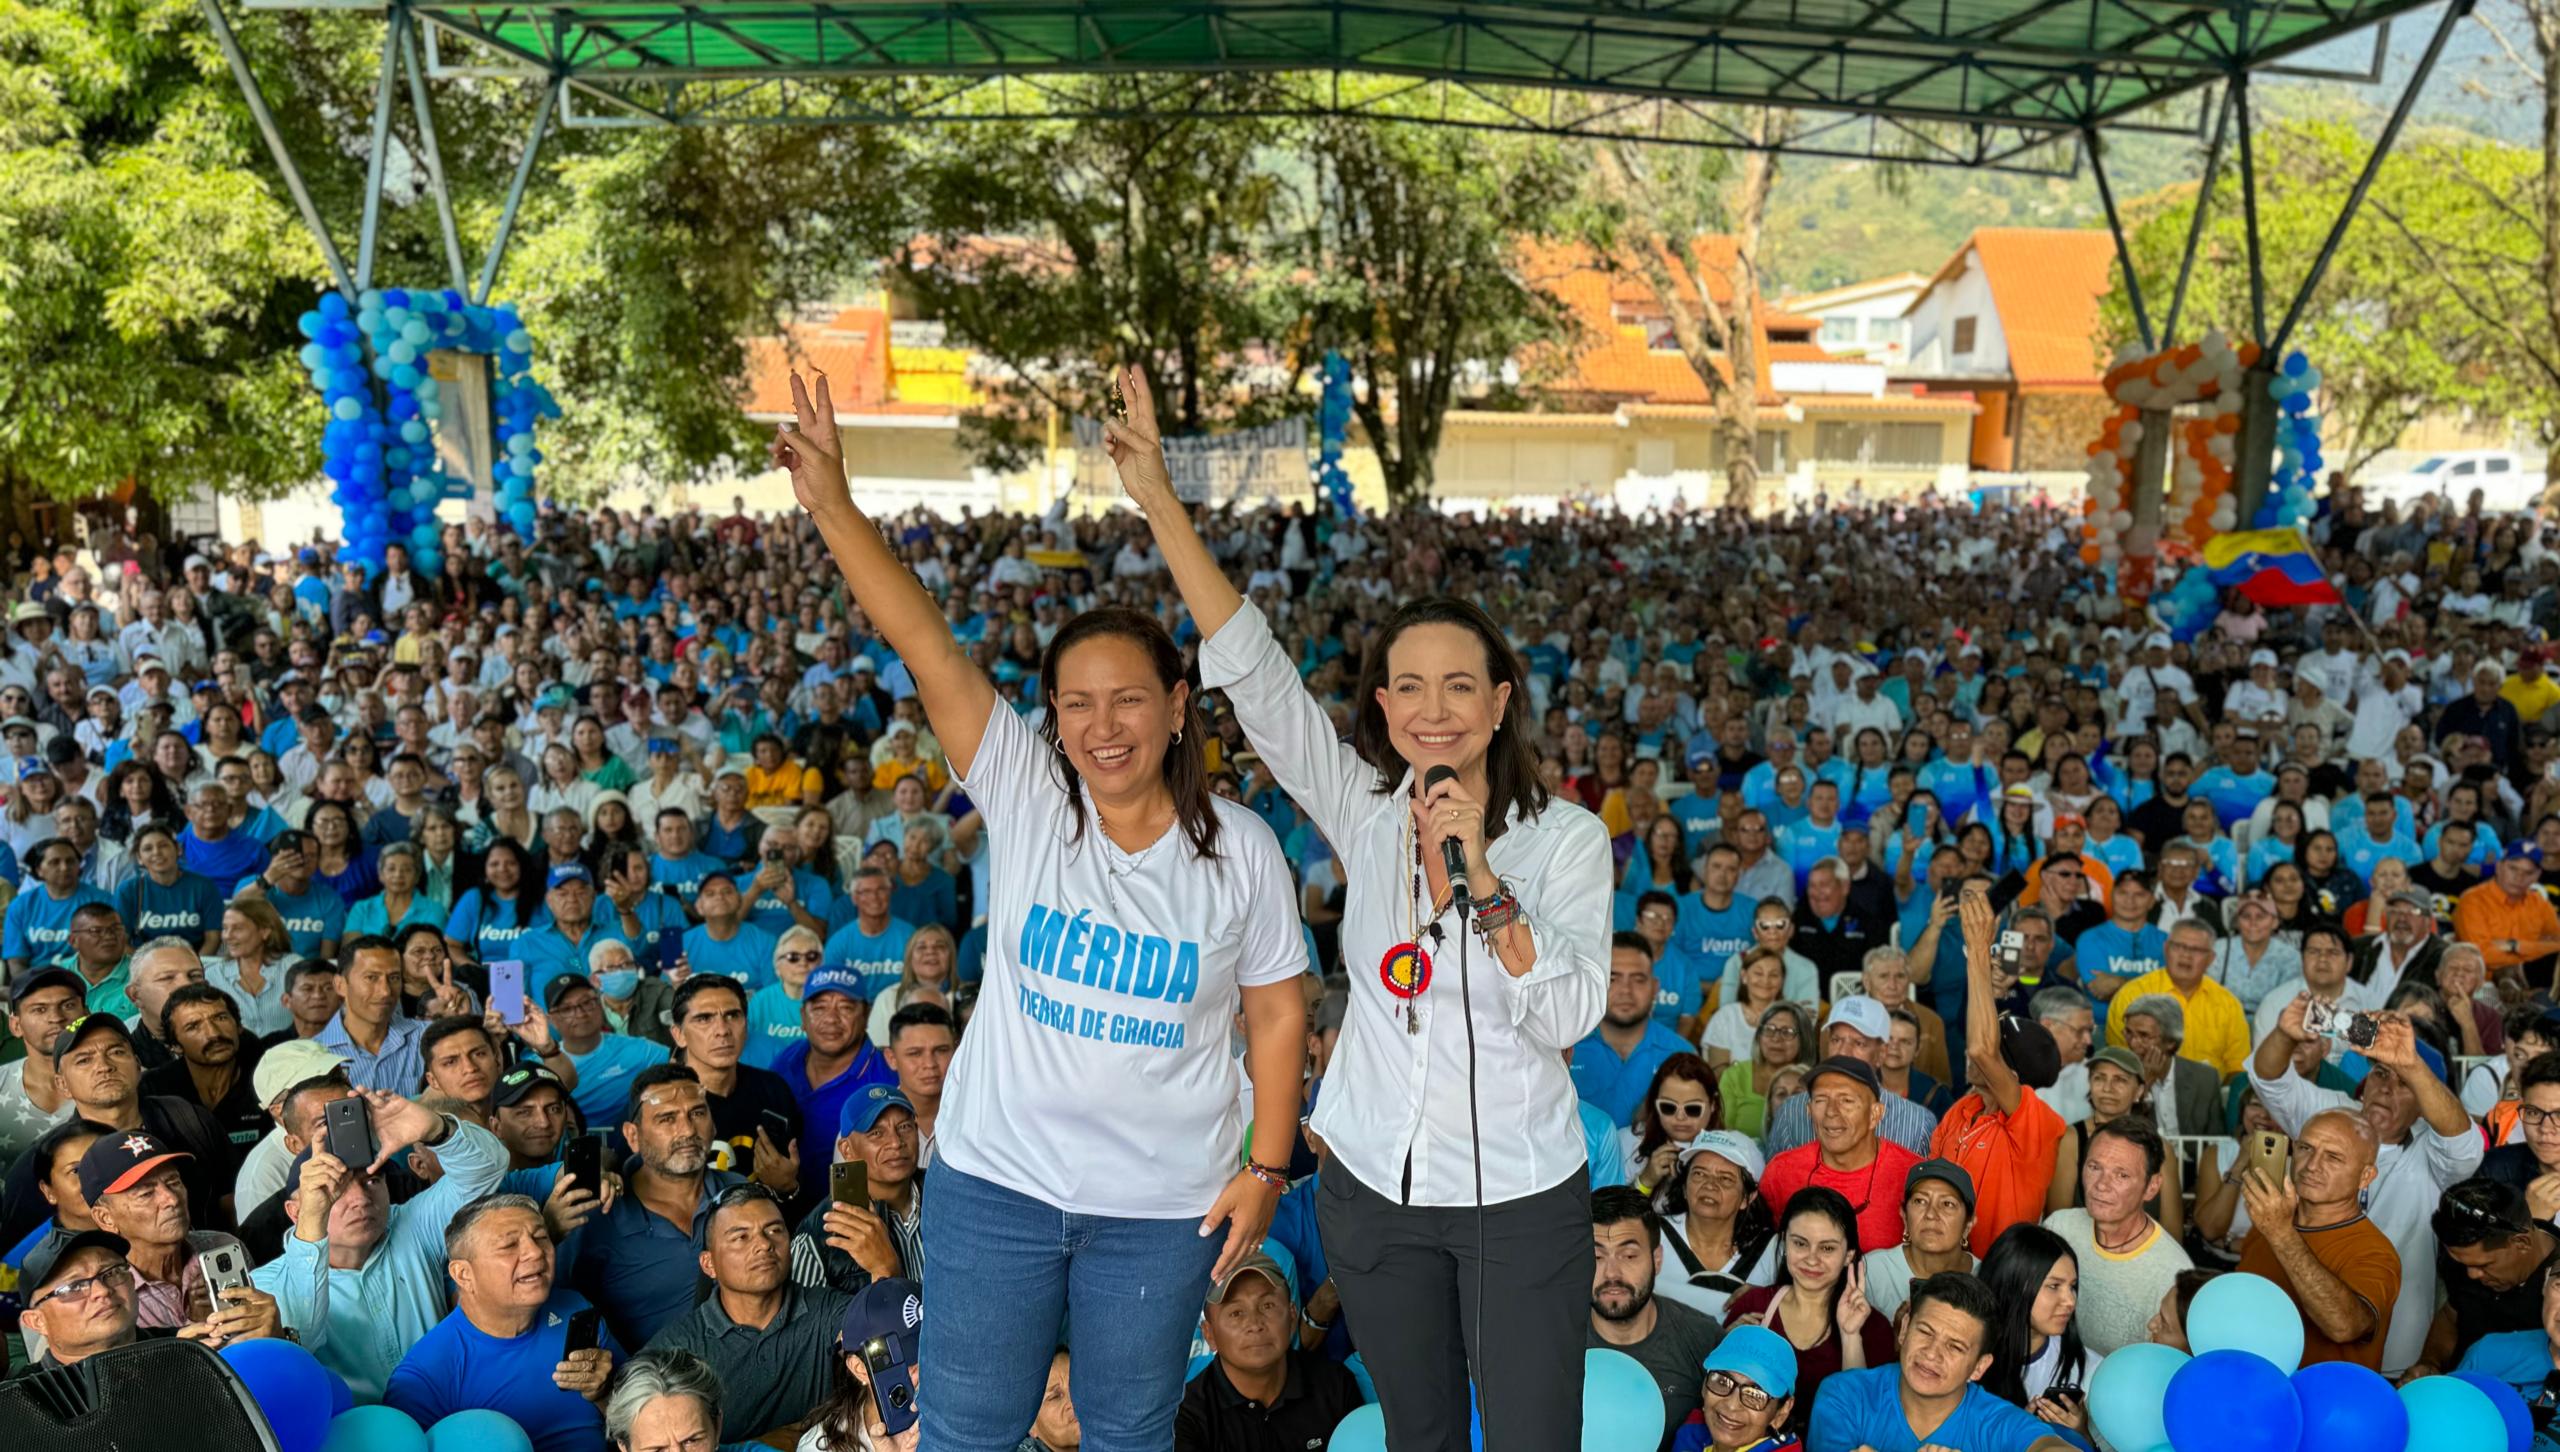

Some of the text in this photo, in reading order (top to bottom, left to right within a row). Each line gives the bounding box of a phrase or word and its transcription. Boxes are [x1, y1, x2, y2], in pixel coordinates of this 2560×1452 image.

[139, 910, 200, 929] Vente
[279, 916, 324, 932] nte
[28, 926, 69, 943] Ven
[1020, 903, 1199, 1004] MÉRIDA
[845, 958, 904, 975] Vente
[811, 970, 857, 986] Vente
[1019, 983, 1185, 1049] TIERRA DE GRACIA
[768, 1023, 807, 1038] Ven
